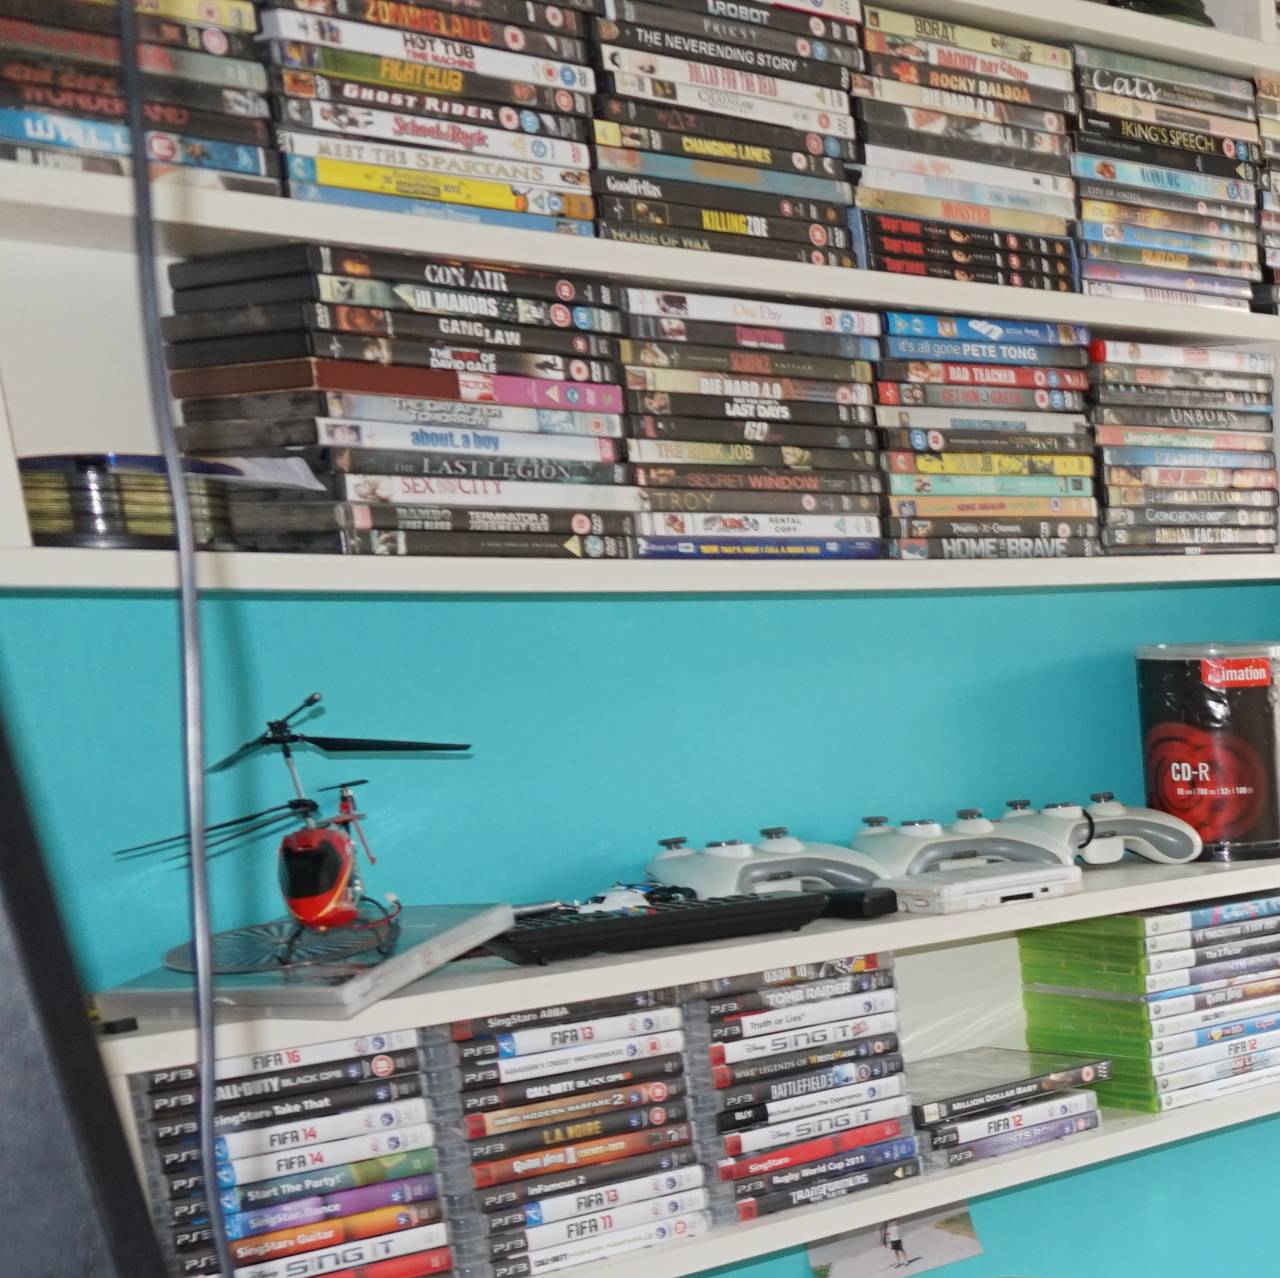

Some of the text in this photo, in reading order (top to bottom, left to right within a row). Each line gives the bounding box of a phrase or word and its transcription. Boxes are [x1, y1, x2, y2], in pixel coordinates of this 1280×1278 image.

[718, 2, 770, 25] ROBOT
[914, 17, 957, 41] BORAT
[402, 32, 475, 60] HOT TUB
[636, 28, 798, 72] THE NEVERENDING STORY
[380, 57, 465, 92] FIGHT CLUB
[929, 71, 1031, 104] ROCKY BALBOA
[1093, 69, 1162, 101] Cats
[343, 82, 495, 121] GHOST RIDER
[1169, 127, 1216, 152] SPEECH
[415, 154, 545, 181] SPARTANS
[425, 265, 508, 292] CON AIR
[435, 290, 499, 317] MANORS
[440, 319, 521, 345] GANG LAW
[430, 348, 451, 360] THE
[918, 340, 930, 354] all
[962, 343, 998, 358] PETE
[1000, 346, 1037, 360] TONG
[430, 358, 497, 373] DAVID GALE
[949, 366, 1016, 384] BAD TEACHER
[725, 402, 791, 419] LAST DAYS
[1170, 408, 1238, 422] UNBORN
[411, 429, 453, 447] about
[473, 432, 500, 450] boy
[729, 446, 754, 460] JOB
[423, 458, 571, 480] LAST LEGION
[402, 479, 503, 495] SEX CITY
[686, 474, 820, 489] SECRET WINDOW
[653, 492, 716, 510] TROY
[467, 511, 539, 523] TERMINATOR
[943, 538, 1068, 559] HOME BRAVE
[1221, 665, 1267, 681] imation
[1171, 762, 1210, 781] CD-R
[766, 983, 850, 1008] TOMB RAIDER
[539, 1007, 569, 1019] ABBA
[710, 1003, 738, 1014] PS3
[750, 1014, 802, 1030] Truth or Lies
[551, 1027, 593, 1046] FIFA 13
[713, 1026, 741, 1038] PS3
[463, 1045, 497, 1058] PS3
[1228, 1039, 1257, 1055] FIFA 12
[252, 1050, 301, 1071] FIFA 16
[759, 1058, 807, 1075] LEGENDS OF
[153, 1069, 195, 1084] PS3
[281, 1074, 317, 1088] BLACK
[318, 1070, 343, 1082] OPS
[465, 1071, 498, 1084] PS3
[576, 1073, 625, 1089] BLACK OPS
[771, 1074, 827, 1099] BATTLEFIELD
[154, 1095, 195, 1110] PS3
[612, 1094, 625, 1105] 2
[952, 1084, 1038, 1111] MILLION DOLLAR BABY
[272, 1098, 331, 1116] Take That
[988, 1118, 1010, 1134] FIFA
[1011, 1114, 1023, 1127] 12
[269, 1126, 317, 1147] FIFA 14
[933, 1134, 958, 1145] PS3
[276, 1151, 324, 1172] FIFA 14
[773, 1155, 866, 1186] Rugby World Cup 2011
[575, 1175, 587, 1185] 2
[789, 1174, 869, 1204] TRANSFORMERS
[247, 1187, 278, 1202] Start
[281, 1183, 302, 1195] The
[485, 1192, 518, 1206] PS3
[577, 1189, 618, 1210] FIFA 13
[303, 1202, 341, 1218] Dance
[567, 1215, 613, 1238] FIFA 11
[297, 1229, 335, 1246] Guitar
[496, 1263, 529, 1278] PS3
